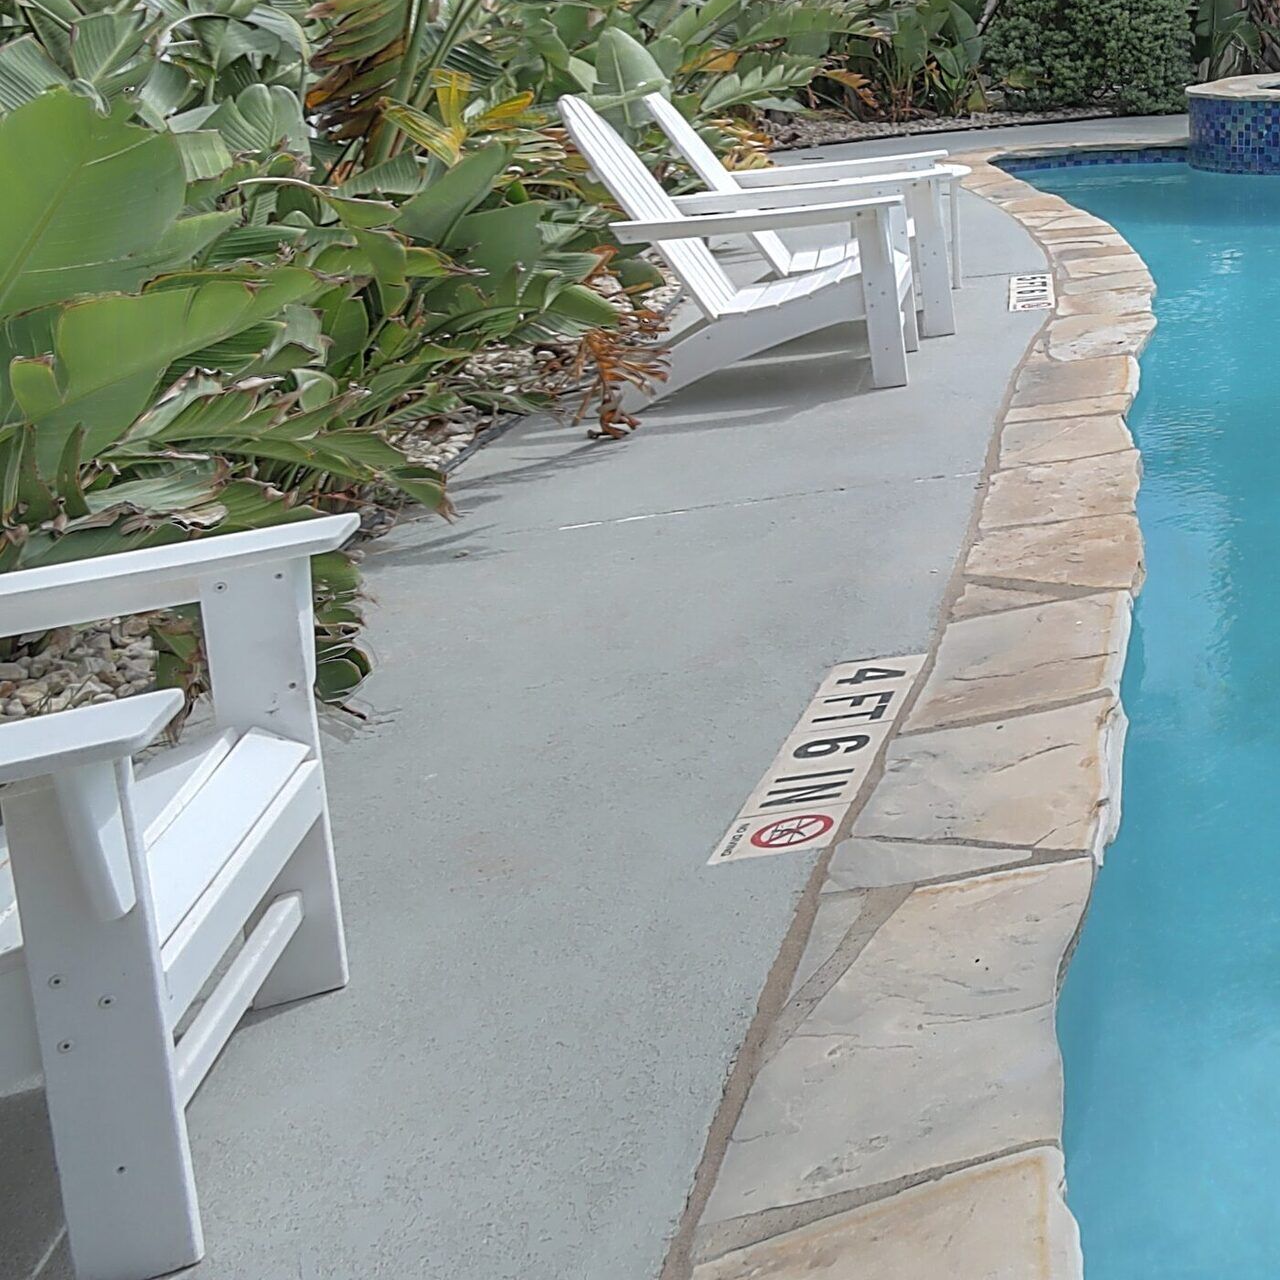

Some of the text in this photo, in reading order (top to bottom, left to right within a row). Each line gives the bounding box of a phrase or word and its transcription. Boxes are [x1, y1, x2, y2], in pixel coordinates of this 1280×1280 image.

[759, 667, 906, 808] 4 FT 6 IN
